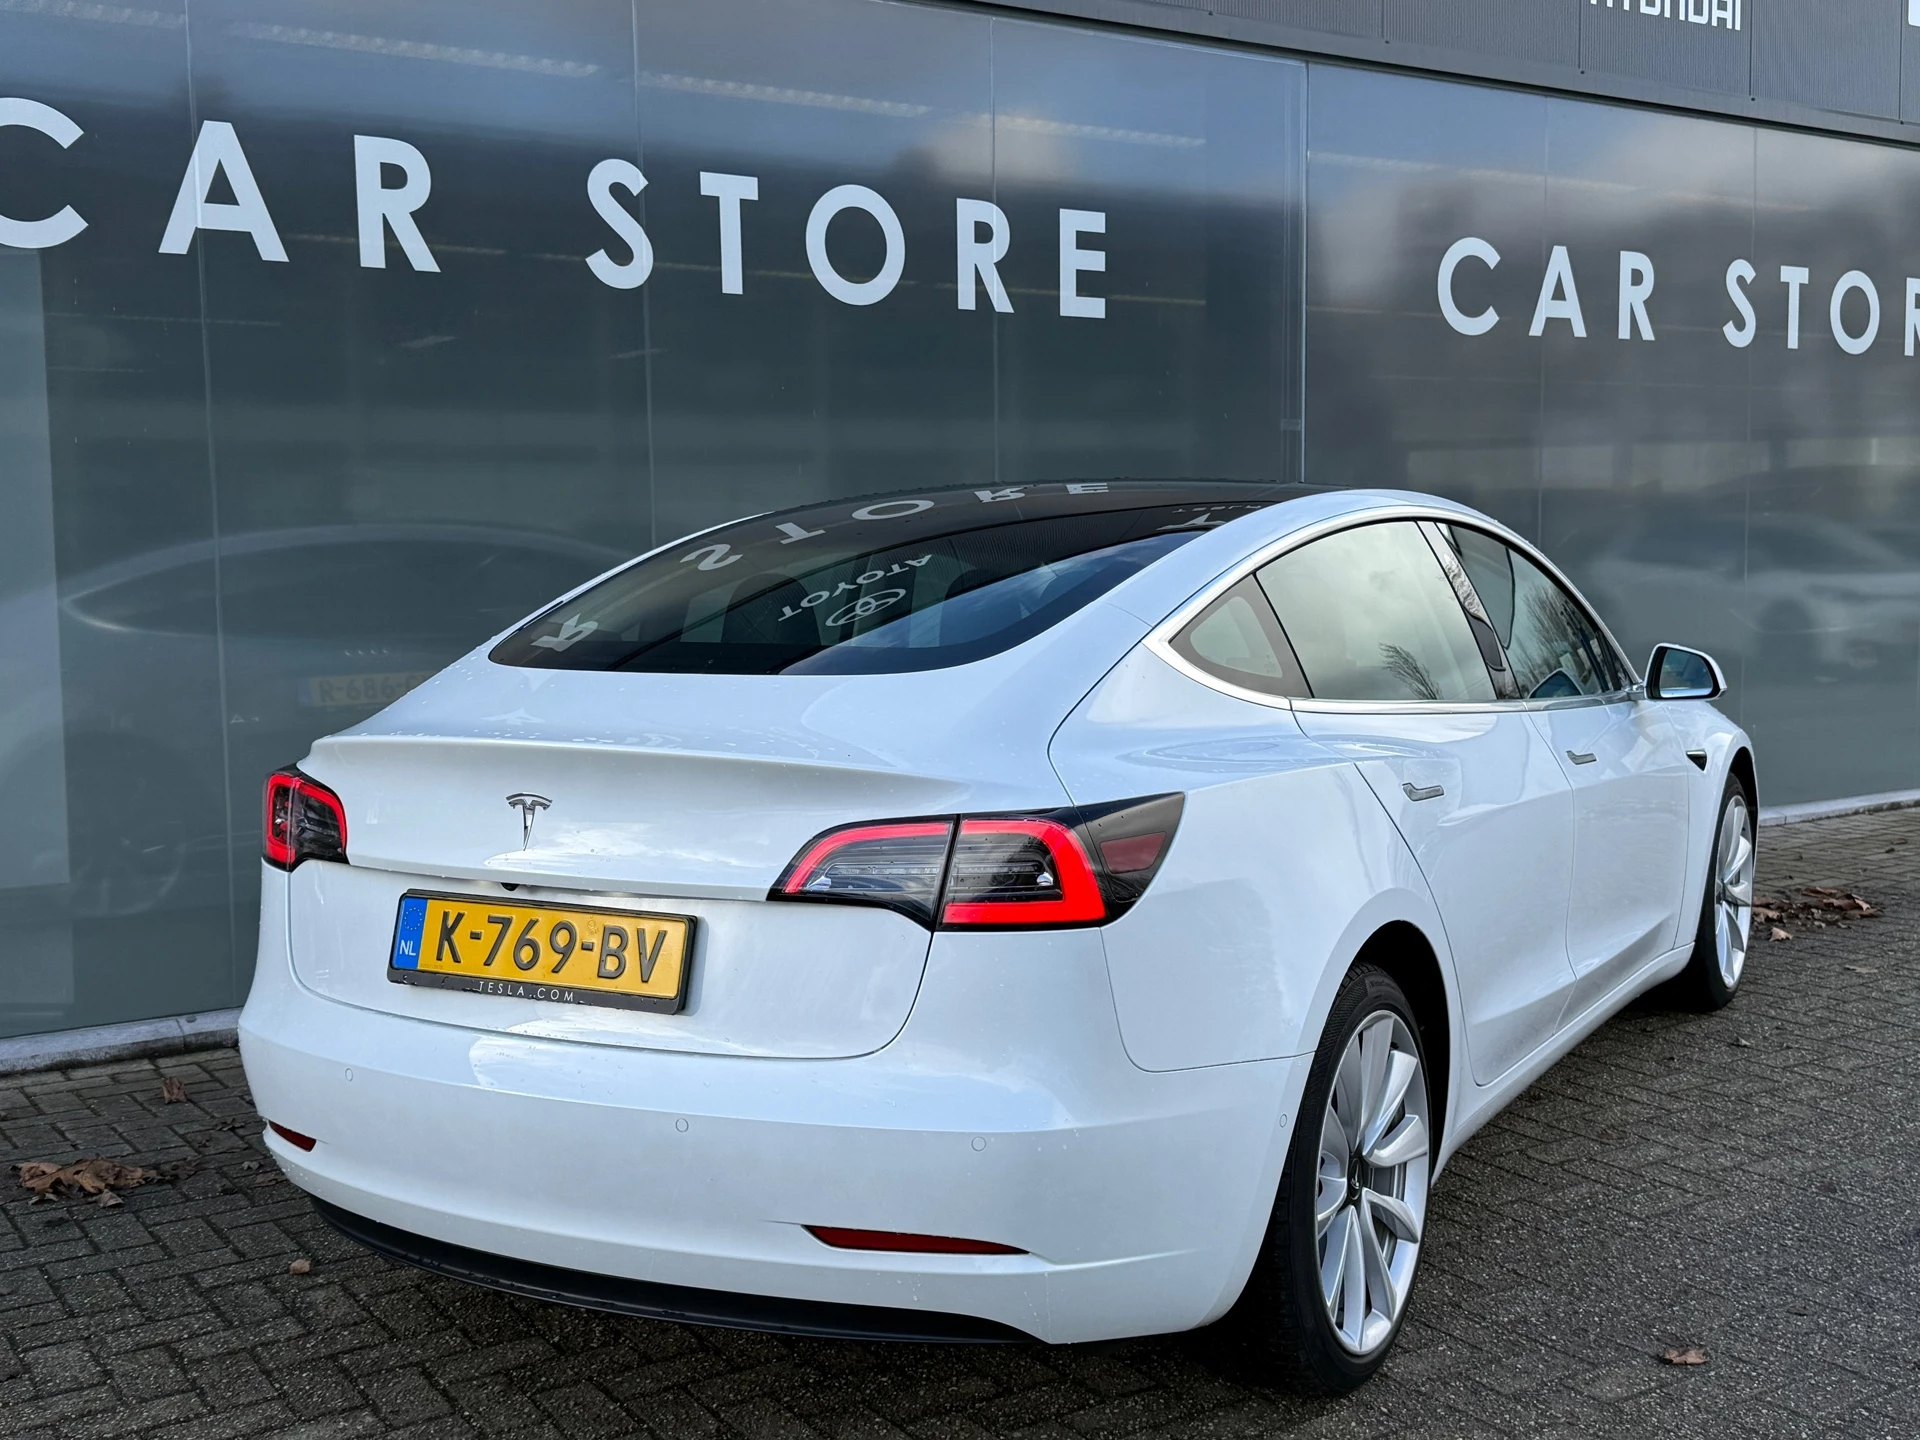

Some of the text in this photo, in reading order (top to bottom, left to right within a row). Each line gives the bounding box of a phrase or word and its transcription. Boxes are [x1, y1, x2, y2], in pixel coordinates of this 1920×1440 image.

[0, 97, 1106, 319] CAR STORE
[1437, 236, 1656, 341] CAR
[399, 939, 417, 956] NL
[436, 910, 667, 983] K-769-BV
[477, 980, 575, 1002] TESLA.COM
